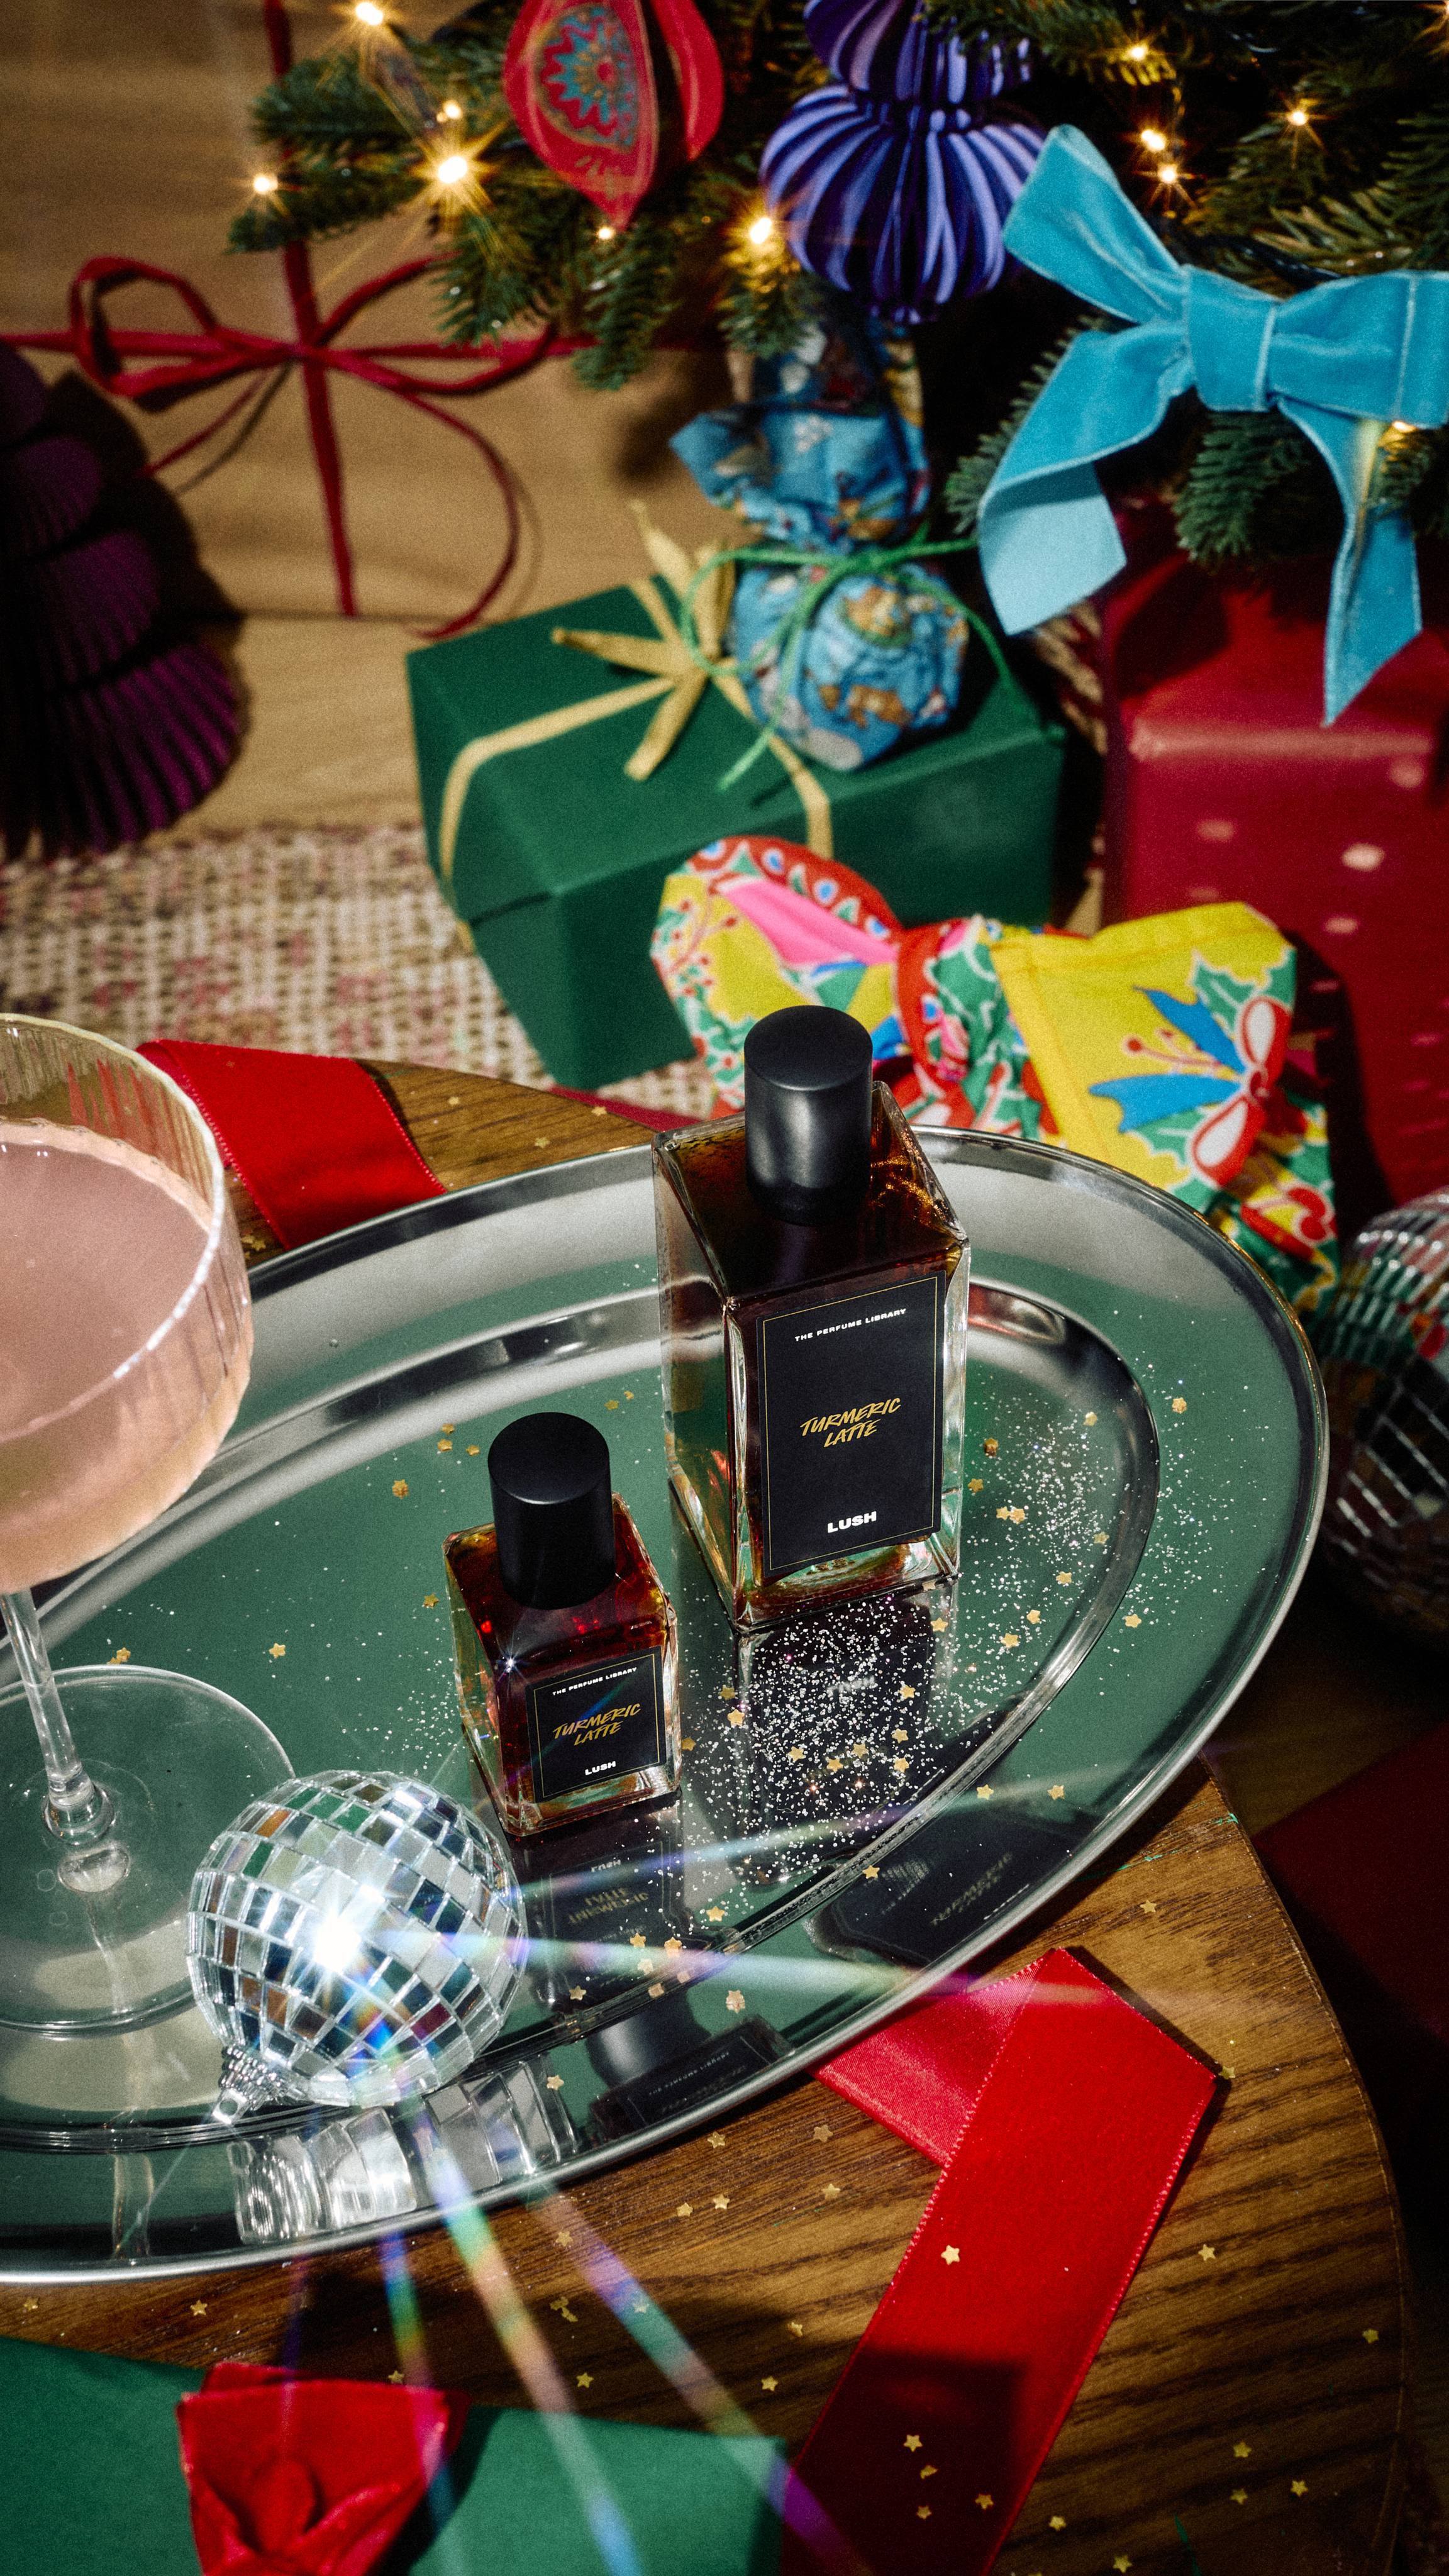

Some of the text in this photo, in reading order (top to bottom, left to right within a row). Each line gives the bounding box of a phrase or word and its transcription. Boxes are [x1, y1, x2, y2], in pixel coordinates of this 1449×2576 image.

[794, 1308, 906, 1341] THE PERFUME LIBRARY
[799, 1397, 901, 1436] TURMERIC
[823, 1419, 881, 1448] LATTE
[827, 1511, 877, 1533] LUSH
[569, 1677, 604, 1691] PERFUME
[605, 1667, 637, 1680] LIBRARY
[552, 1703, 641, 1740] TURMERIC
[574, 1721, 624, 1746] LATTE
[584, 1761, 616, 1776] LUSH
